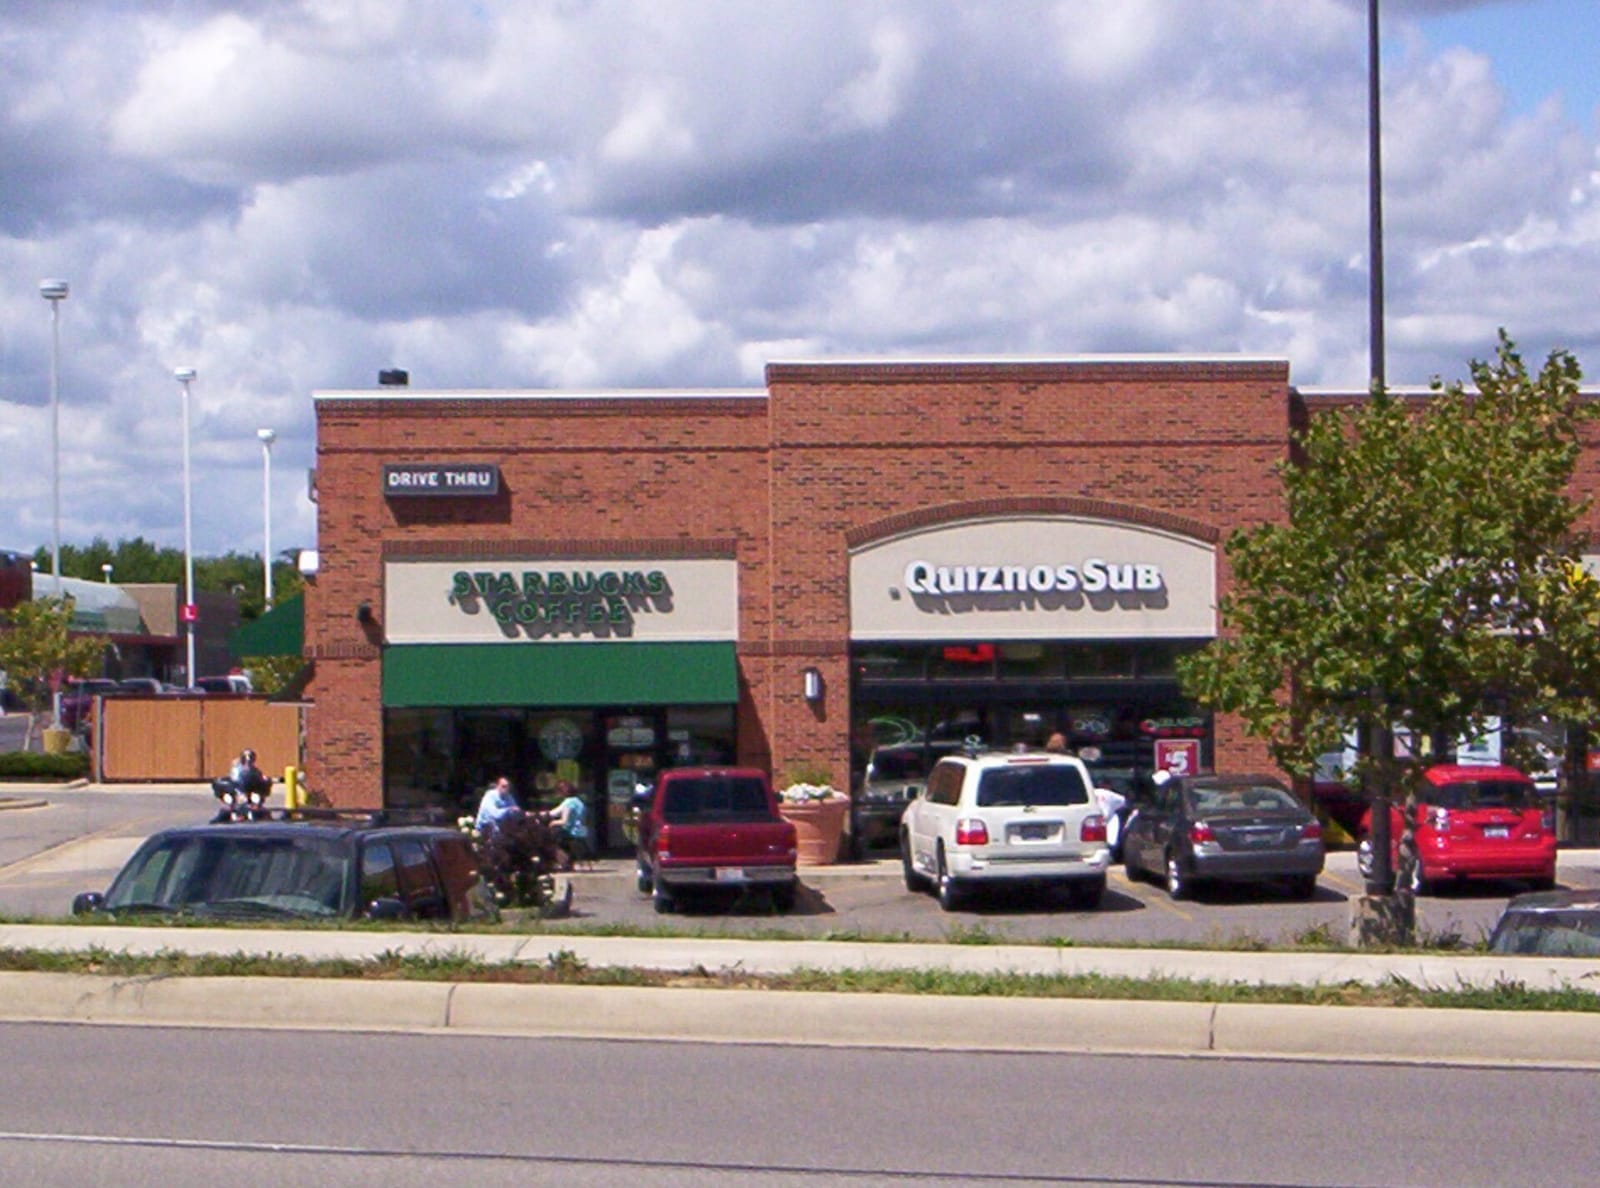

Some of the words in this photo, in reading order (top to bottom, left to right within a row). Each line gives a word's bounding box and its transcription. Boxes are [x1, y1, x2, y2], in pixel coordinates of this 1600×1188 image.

[388, 471, 439, 486] DRIVE
[444, 471, 491, 486] THRU
[452, 570, 668, 595] STARBUCKS
[495, 599, 628, 624] COFFEE
